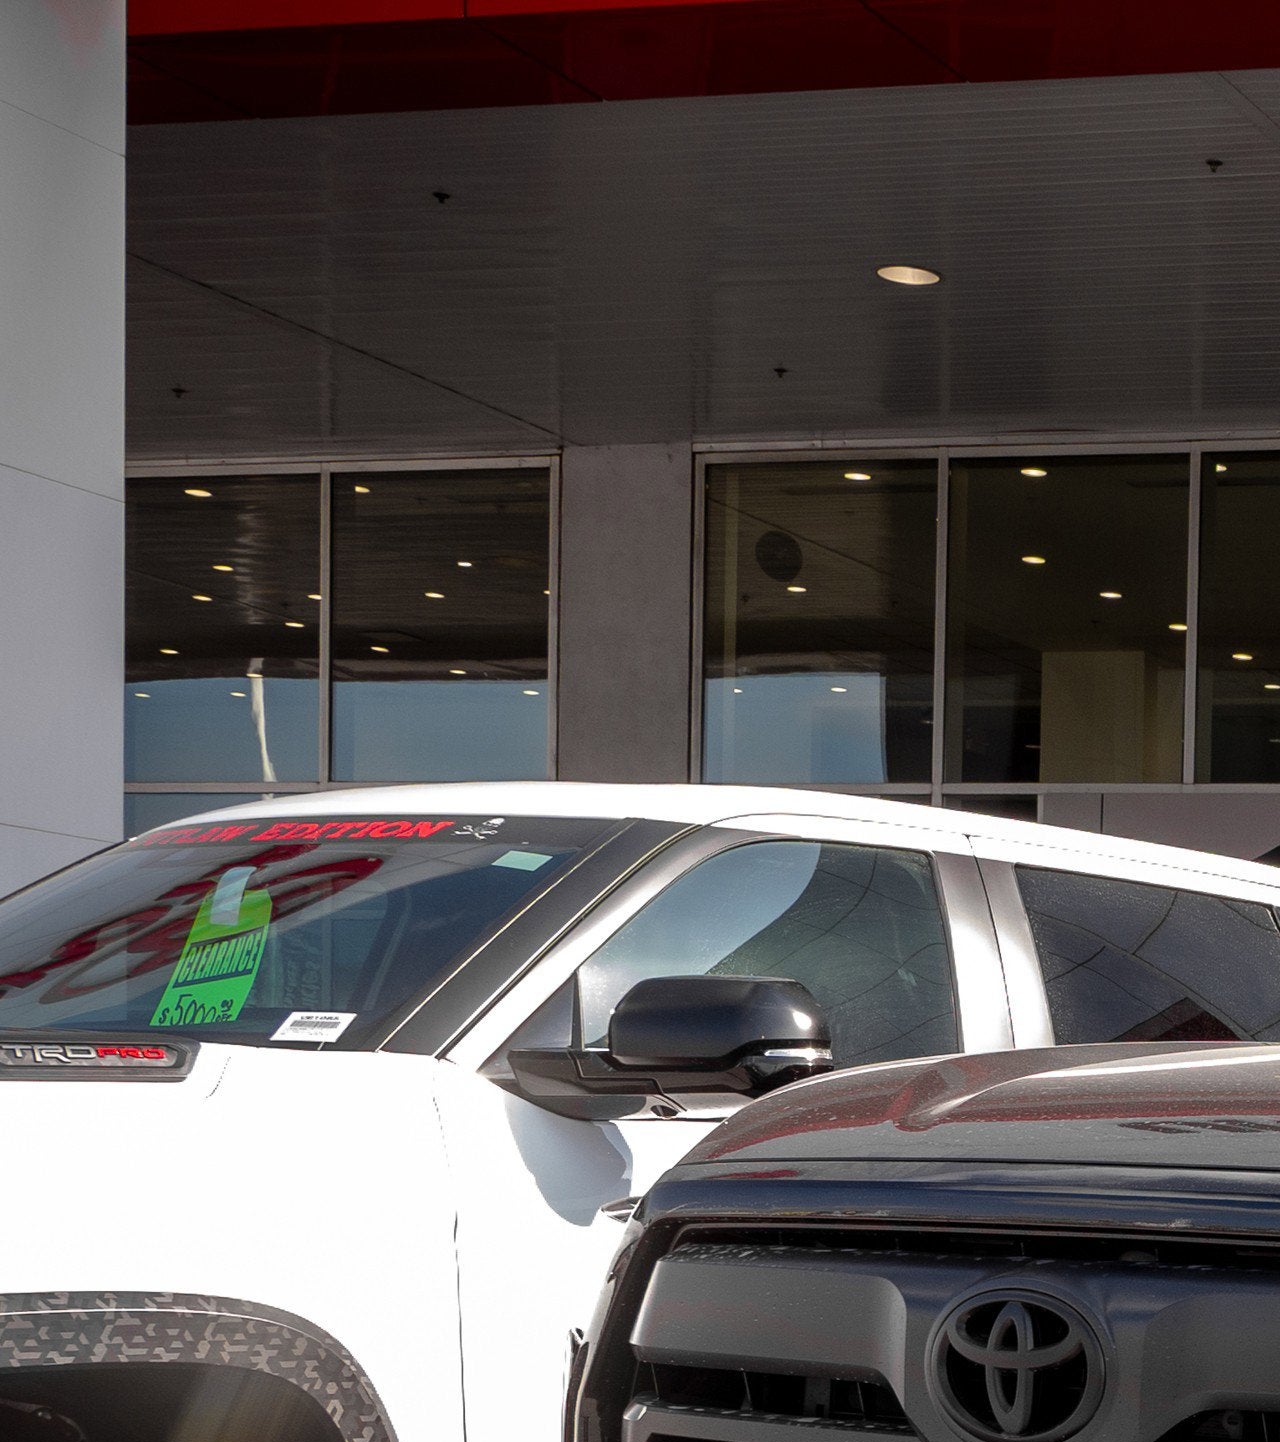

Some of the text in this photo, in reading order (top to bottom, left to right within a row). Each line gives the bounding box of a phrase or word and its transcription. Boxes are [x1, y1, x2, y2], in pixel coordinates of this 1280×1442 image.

[251, 820, 456, 843] EDITION
[178, 931, 263, 984] CLEARANCE
[0, 1044, 167, 1063] TRD PRO
